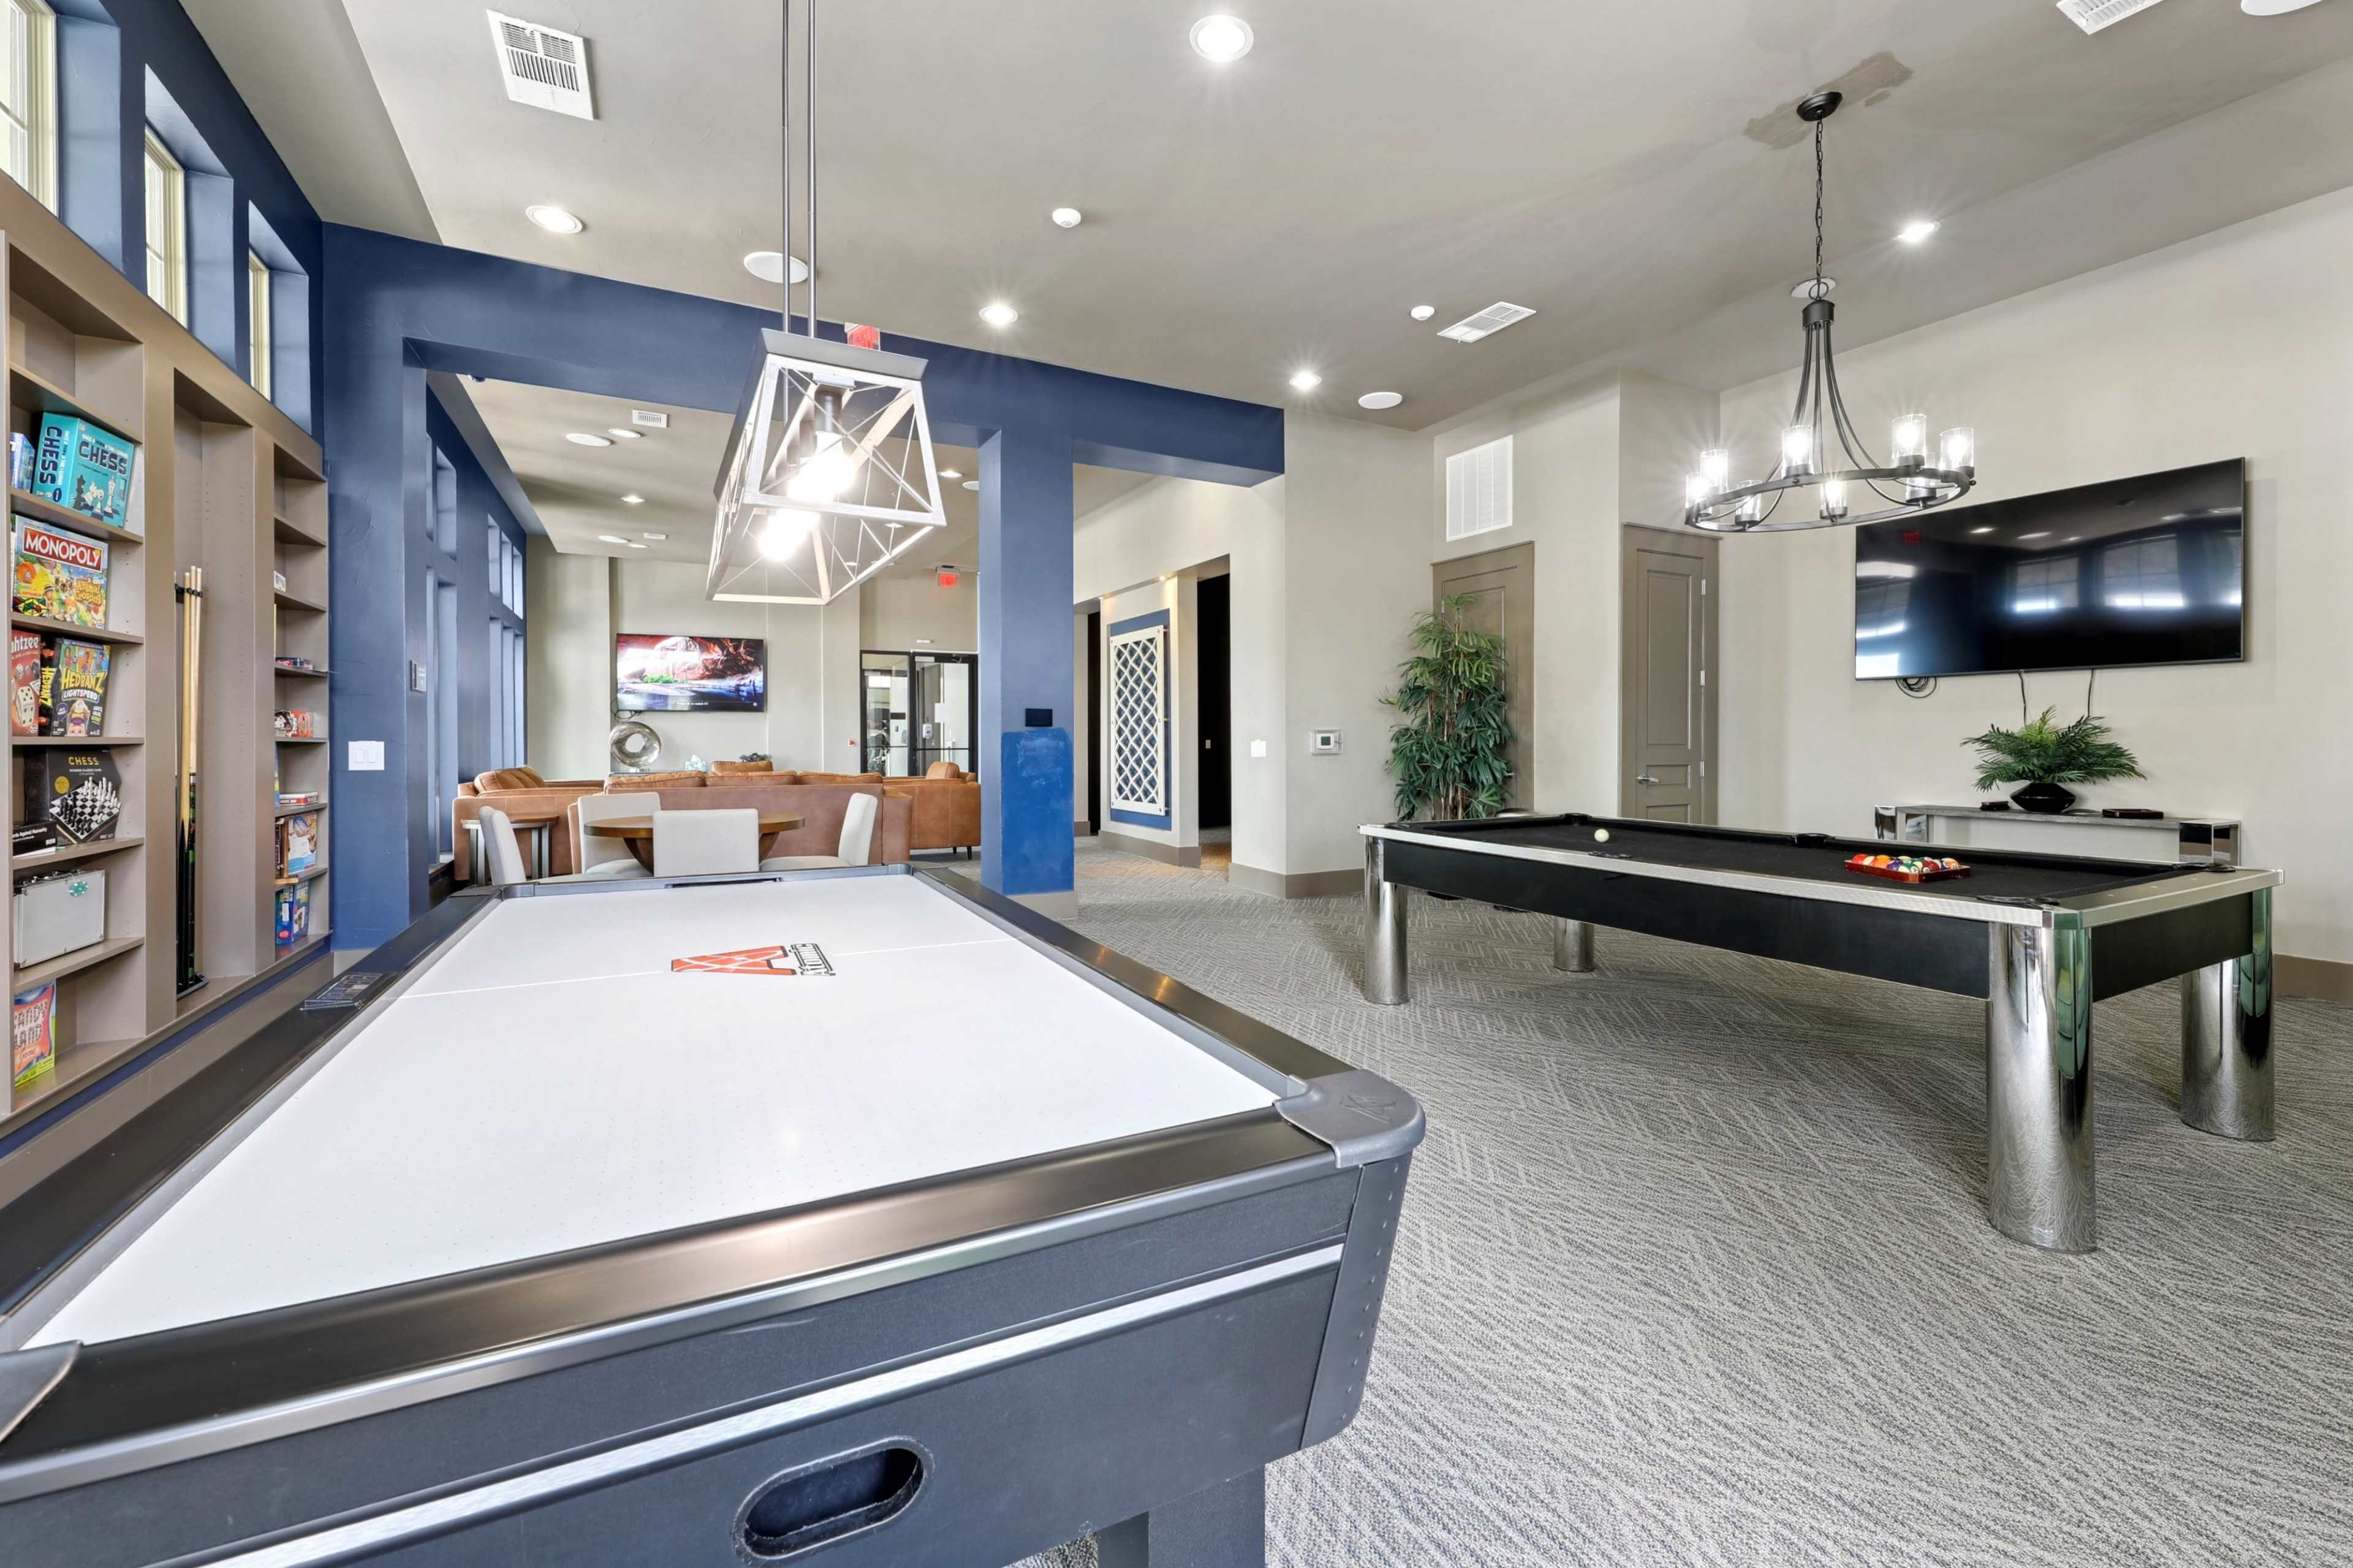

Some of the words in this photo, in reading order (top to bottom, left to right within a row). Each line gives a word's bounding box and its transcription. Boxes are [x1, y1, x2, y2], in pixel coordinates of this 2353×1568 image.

[39, 426, 63, 485] CHESS
[78, 440, 127, 475] CHESS
[25, 531, 101, 567] MONOPOLY
[11, 635, 39, 654] htzee
[39, 667, 58, 708] HEDBANZ
[59, 667, 107, 694] HEDBANZ
[63, 689, 99, 700] LIGHTSPEED
[69, 757, 99, 765] CHESS
